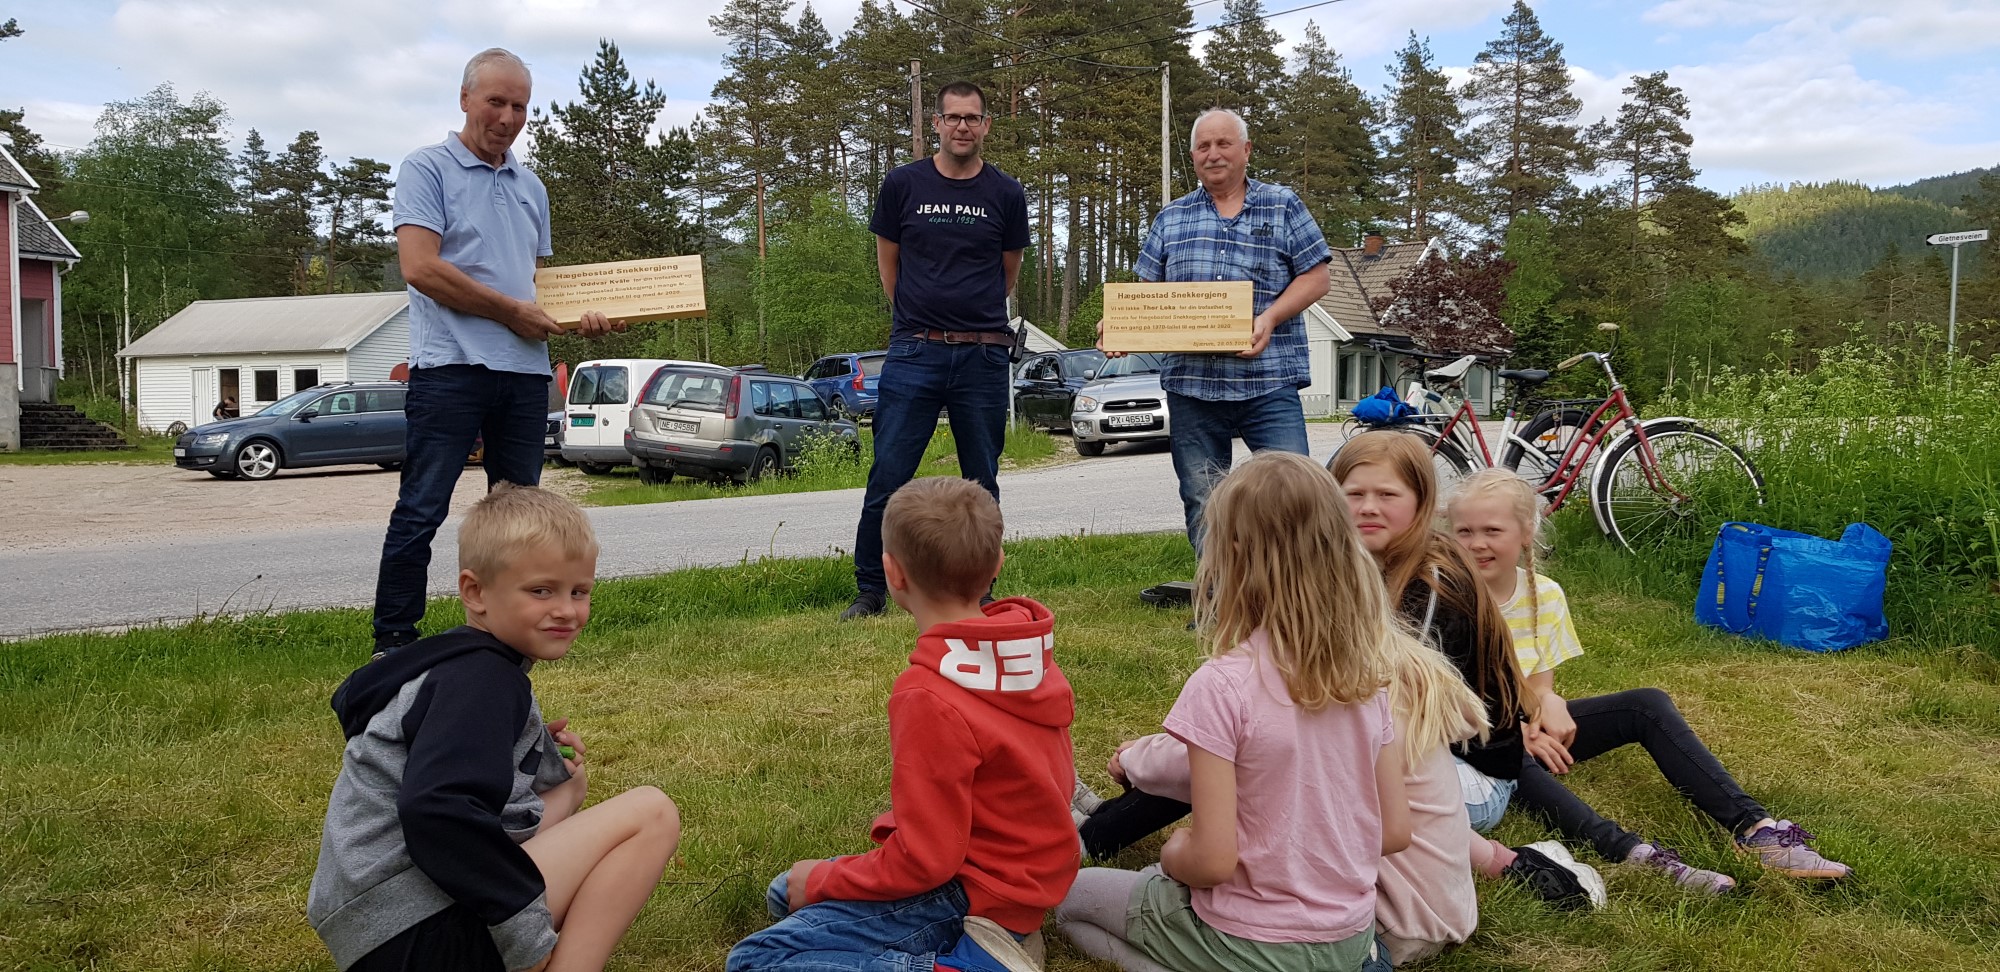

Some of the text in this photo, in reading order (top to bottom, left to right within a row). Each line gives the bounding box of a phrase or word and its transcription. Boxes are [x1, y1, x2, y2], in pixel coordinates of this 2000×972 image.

[916, 204, 988, 218] JEAN PAUL
[928, 216, 952, 224] depuis
[556, 264, 679, 280] Hægebostad Snekkergjeng
[1117, 291, 1227, 300] Hægebostad Snekkergjeng
[662, 420, 671, 428] NE
[1110, 415, 1151, 424] PX 46519
